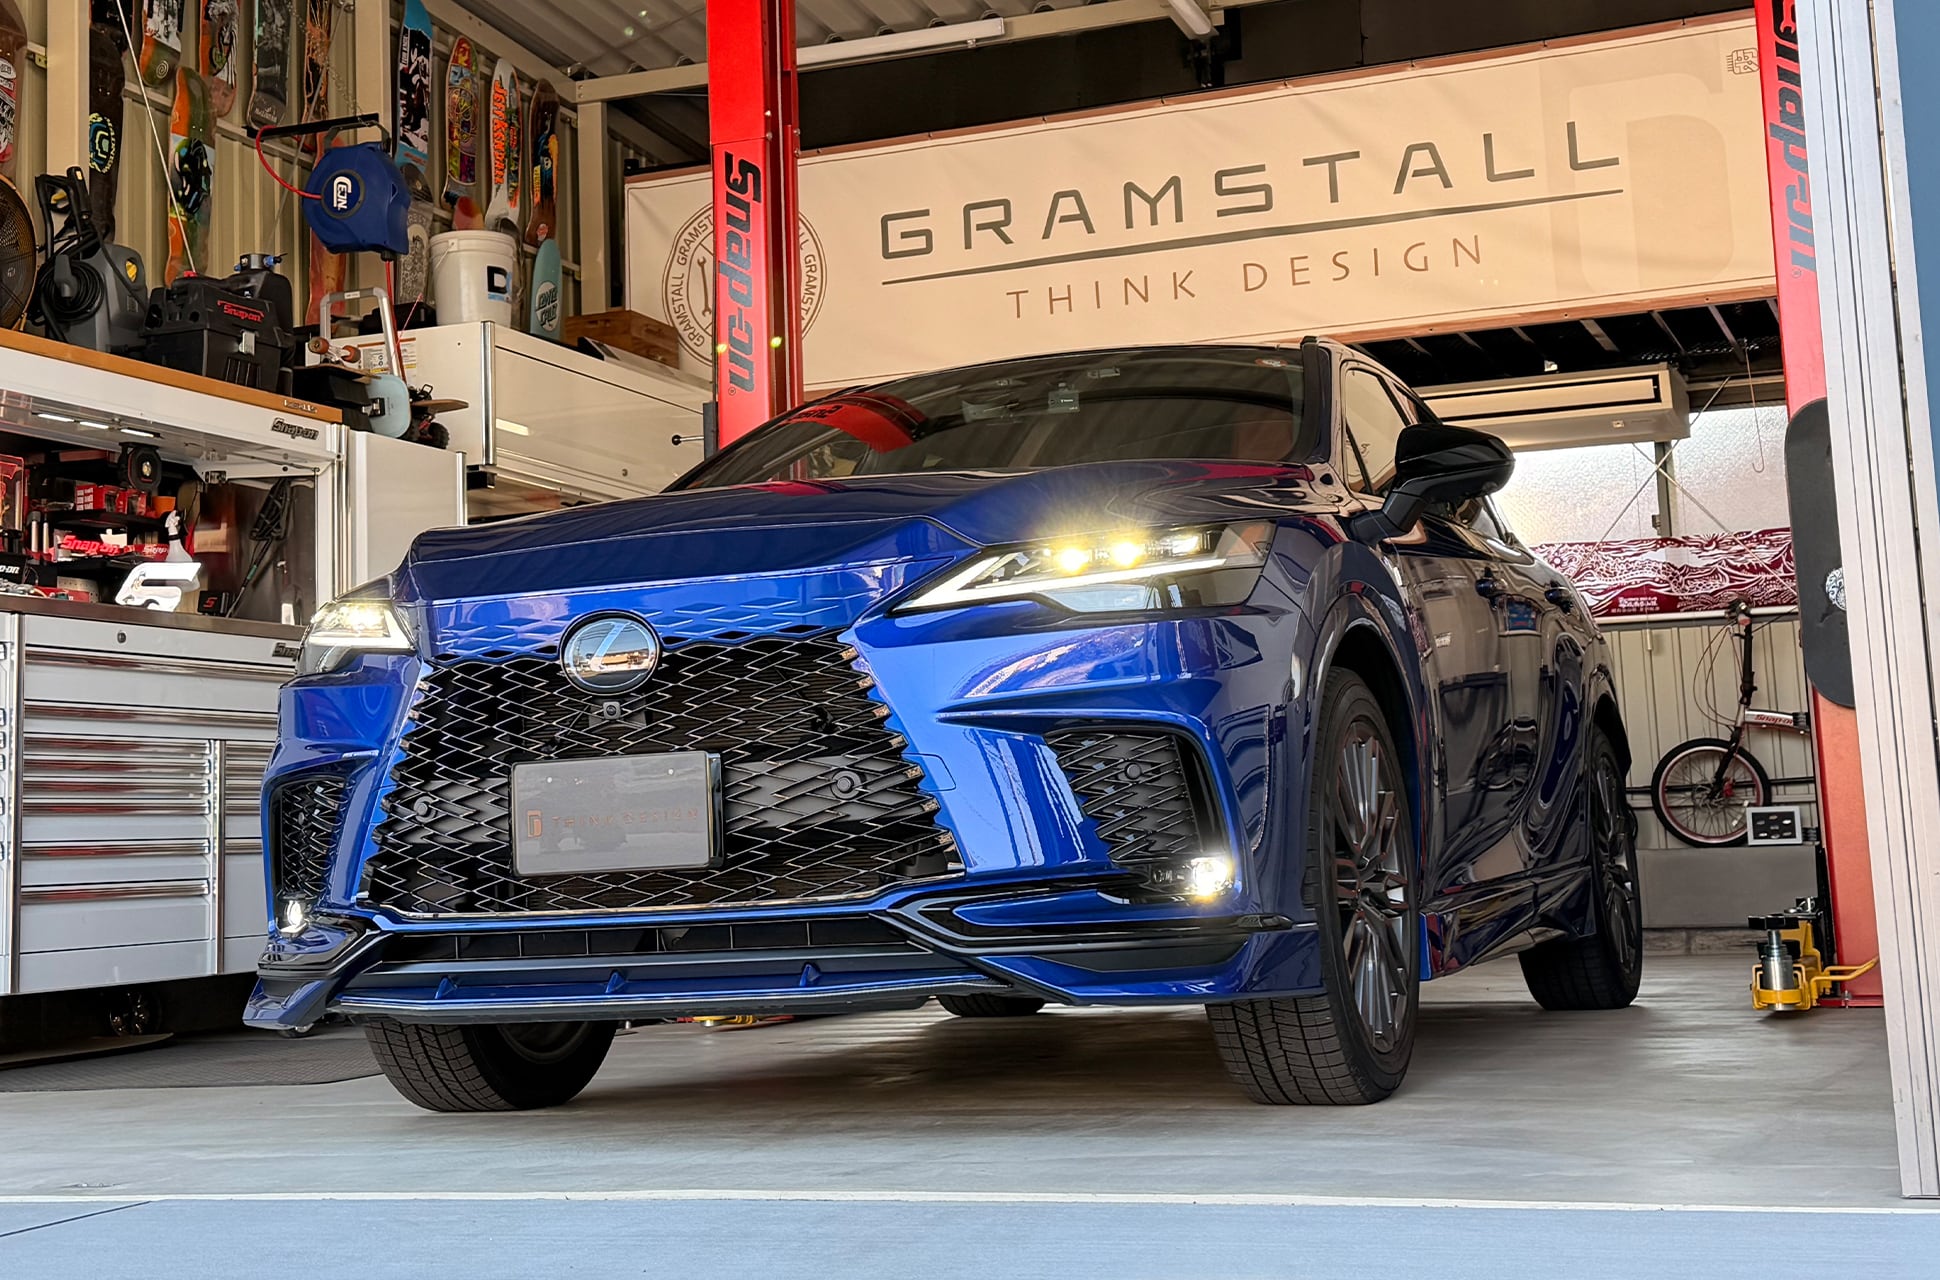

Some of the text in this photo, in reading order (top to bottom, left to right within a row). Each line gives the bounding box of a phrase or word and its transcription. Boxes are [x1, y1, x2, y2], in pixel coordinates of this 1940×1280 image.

[881, 121, 1619, 259] GRAMSTALL
[677, 214, 713, 266] GRAMST
[800, 254, 818, 321] GRAMST
[1006, 234, 1482, 319] THINK DESIGN
[671, 273, 705, 347] GRAMSTALL
[60, 534, 120, 556] Snap-on
[142, 544, 168, 556] Snap
[272, 642, 299, 662] Sna
